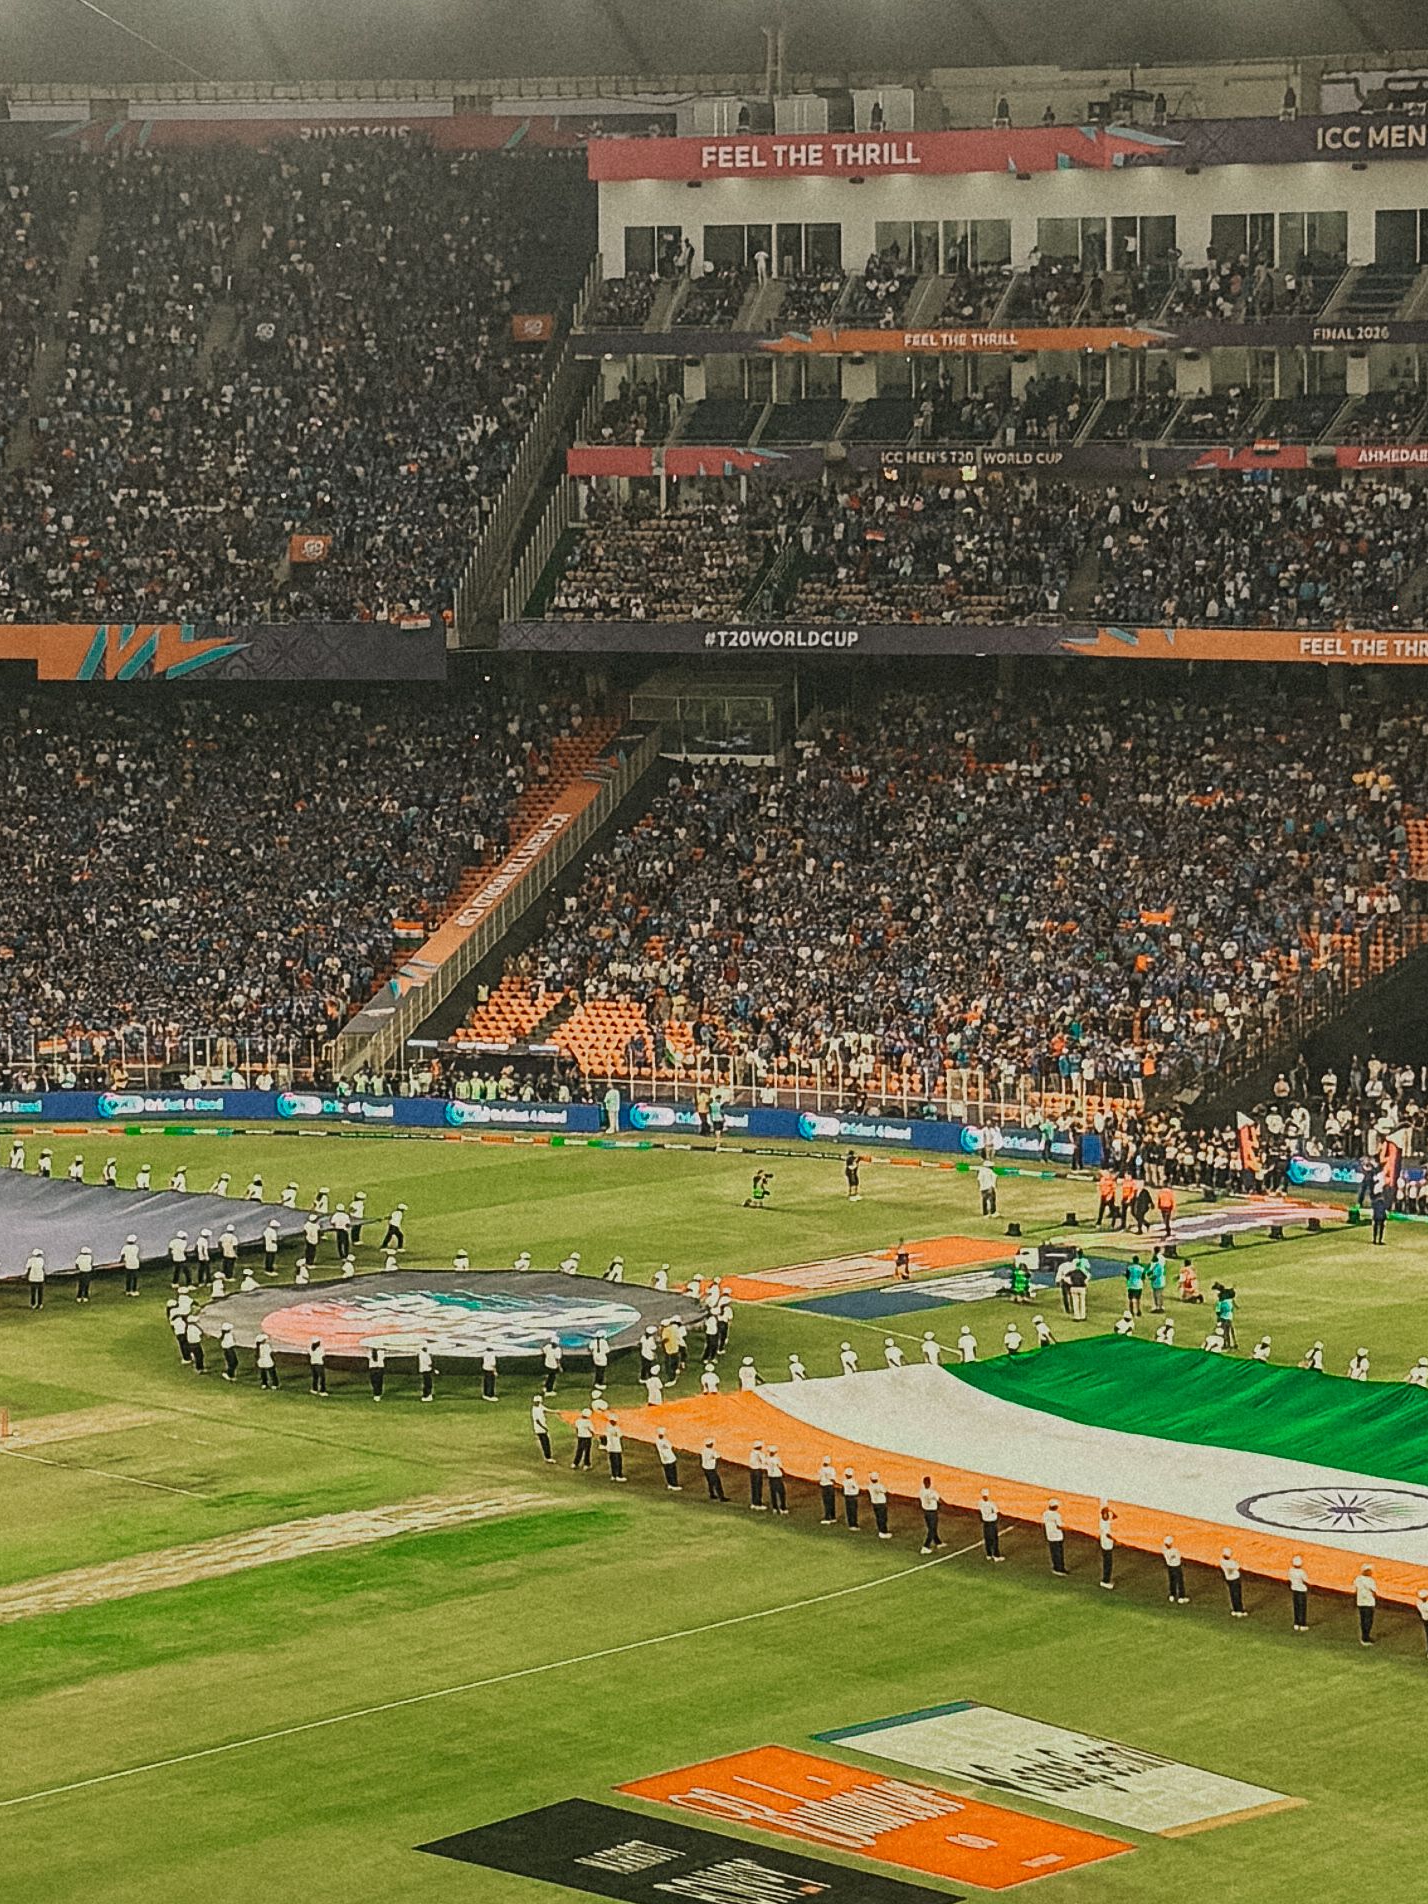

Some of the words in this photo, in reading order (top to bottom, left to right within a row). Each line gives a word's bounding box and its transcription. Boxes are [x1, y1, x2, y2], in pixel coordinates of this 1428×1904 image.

[1317, 126, 1361, 150] ICC
[702, 144, 766, 168] FEEL
[773, 143, 824, 167] THE
[833, 141, 921, 165] THRILL
[904, 333, 936, 348] FEEL
[942, 333, 966, 348] THE
[970, 332, 1018, 347] THRILL
[1313, 328, 1354, 341] FINAL
[1356, 326, 1390, 340] 2026
[983, 451, 1031, 465] WORLD
[1035, 451, 1063, 465] CUP
[704, 629, 859, 649] #T20WORLDCUP
[1300, 637, 1346, 657] FEEL
[1351, 638, 1389, 658] THE
